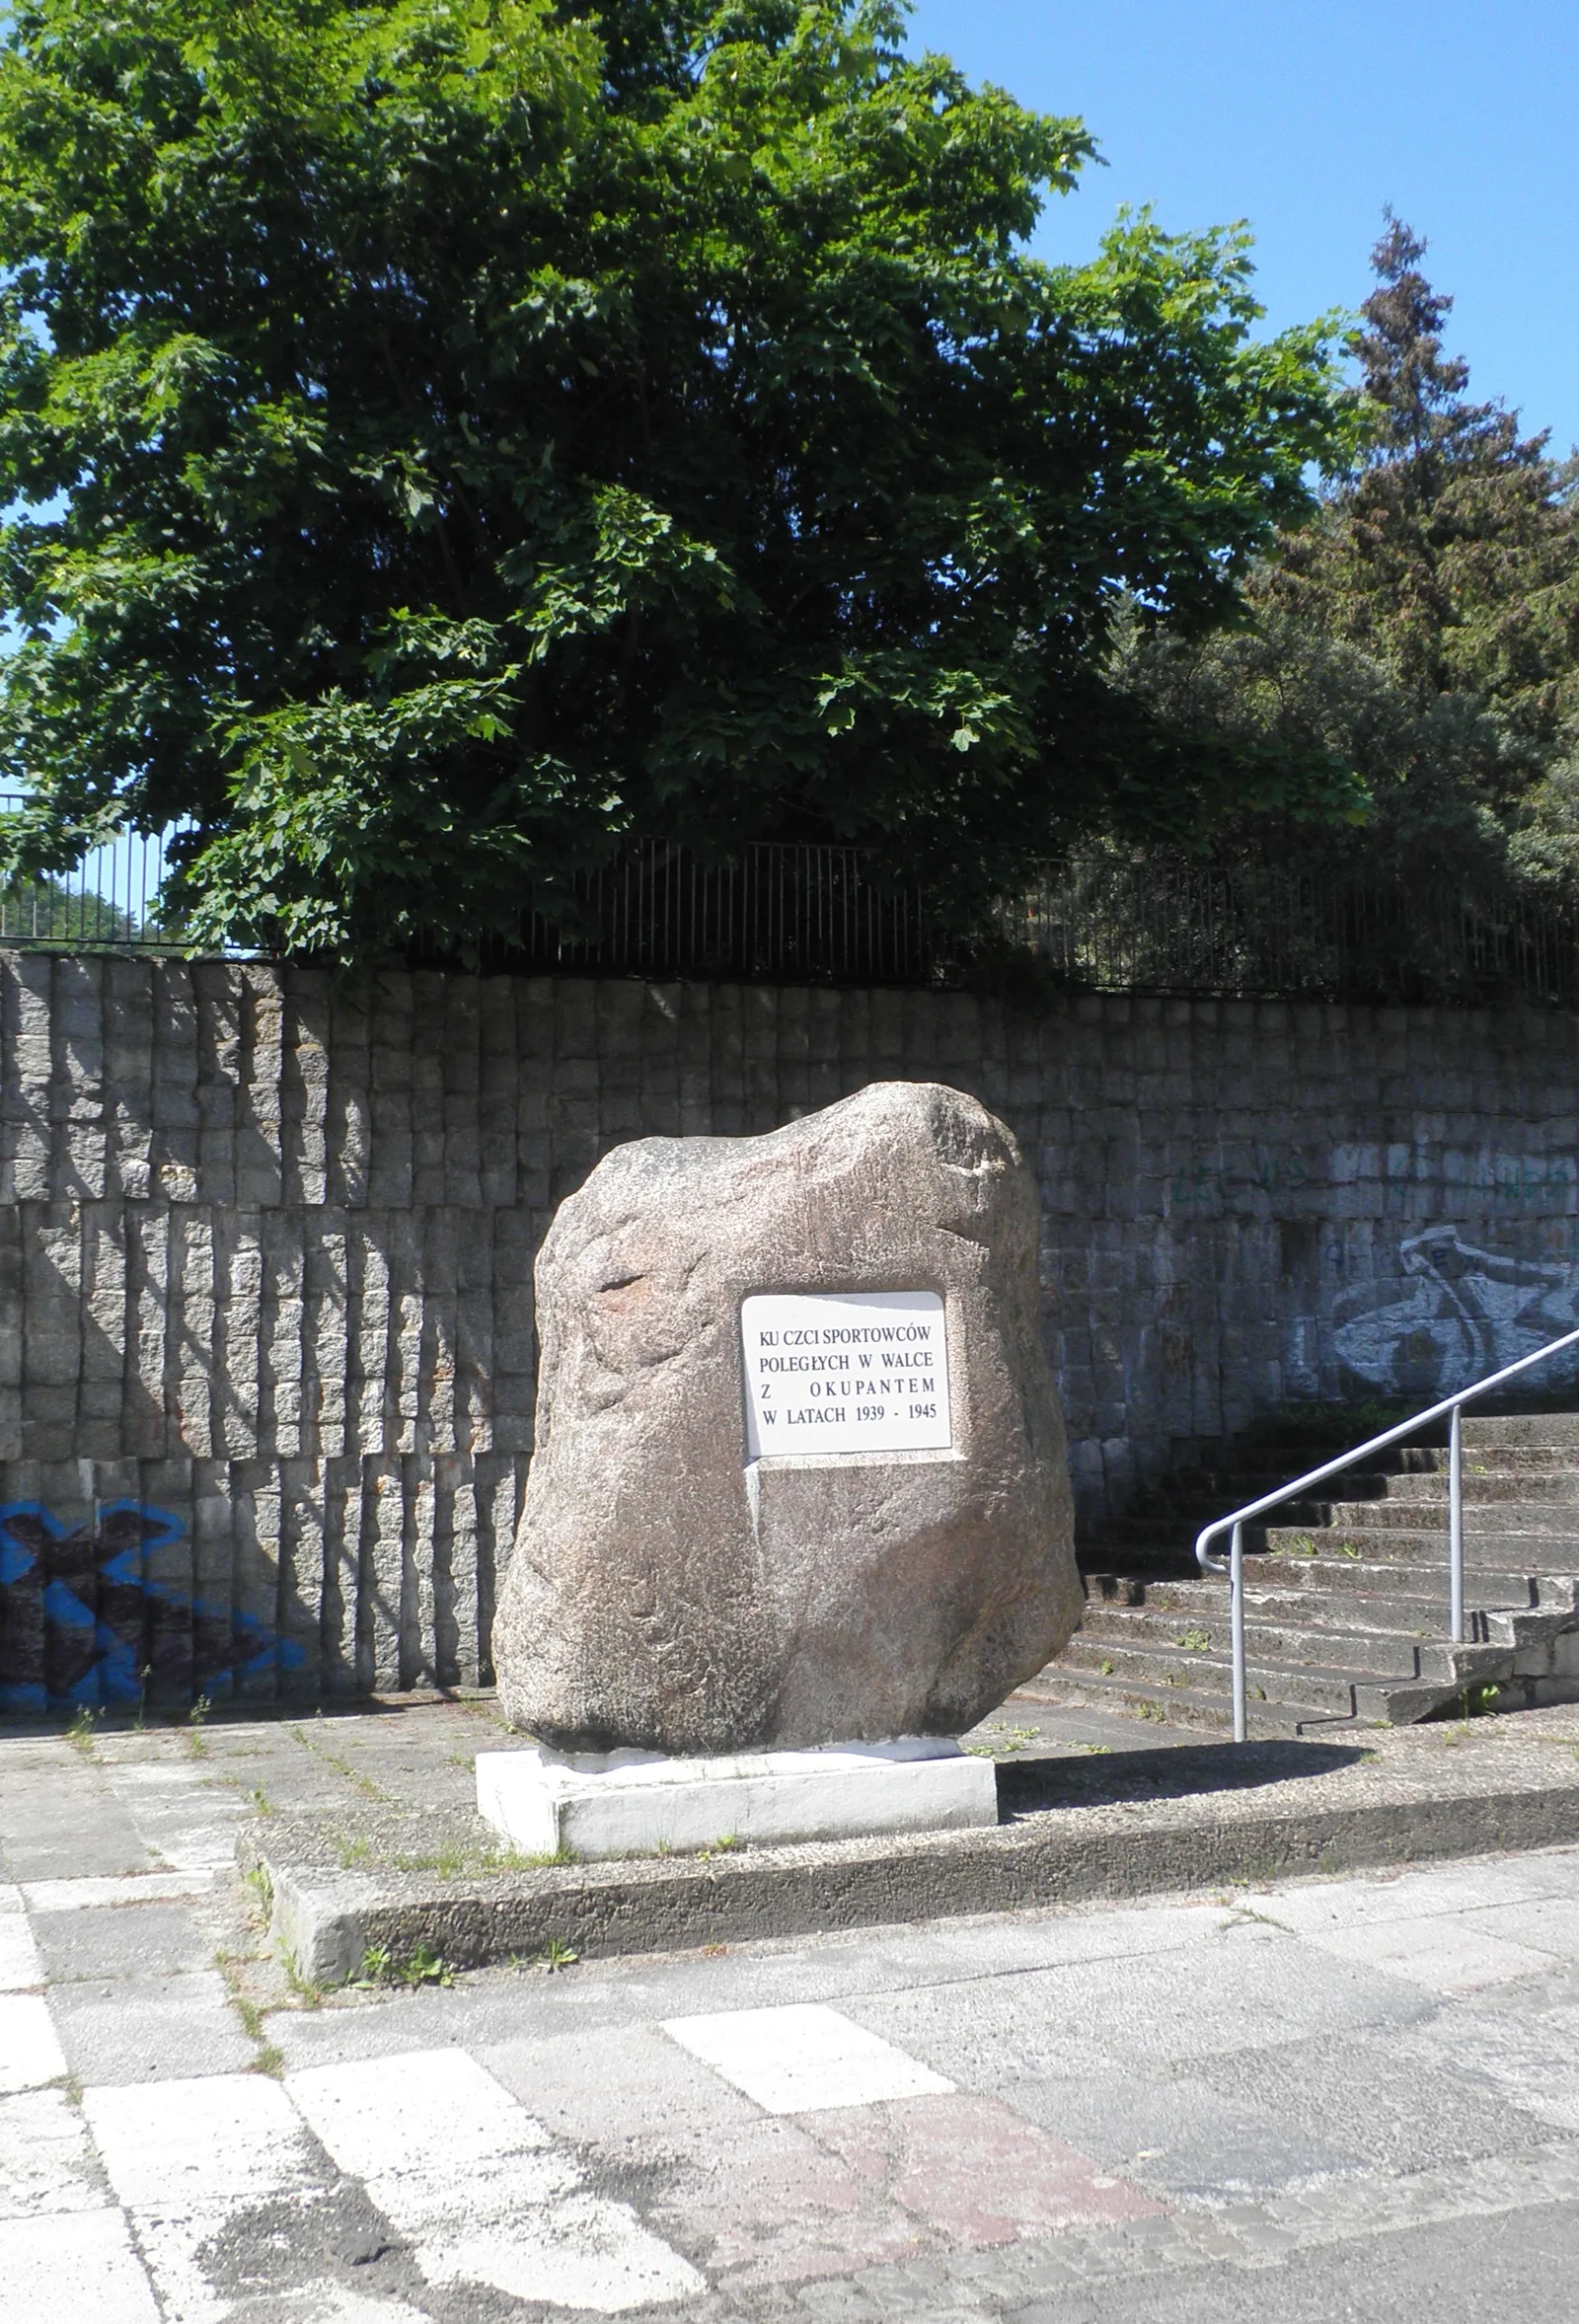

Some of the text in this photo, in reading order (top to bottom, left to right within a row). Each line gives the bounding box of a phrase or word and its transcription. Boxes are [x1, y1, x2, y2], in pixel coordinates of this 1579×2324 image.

[759, 1322, 932, 1346] KU CZCI SPORTOWCÓW
[759, 1352, 934, 1373] POLEGŁYCH W WALCE
[761, 1378, 936, 1399] Z OKUPANTEM
[763, 1409, 778, 1425] W
[787, 1407, 846, 1425] LATACH
[856, 1405, 885, 1422] 1939
[908, 1403, 938, 1419] 1945
